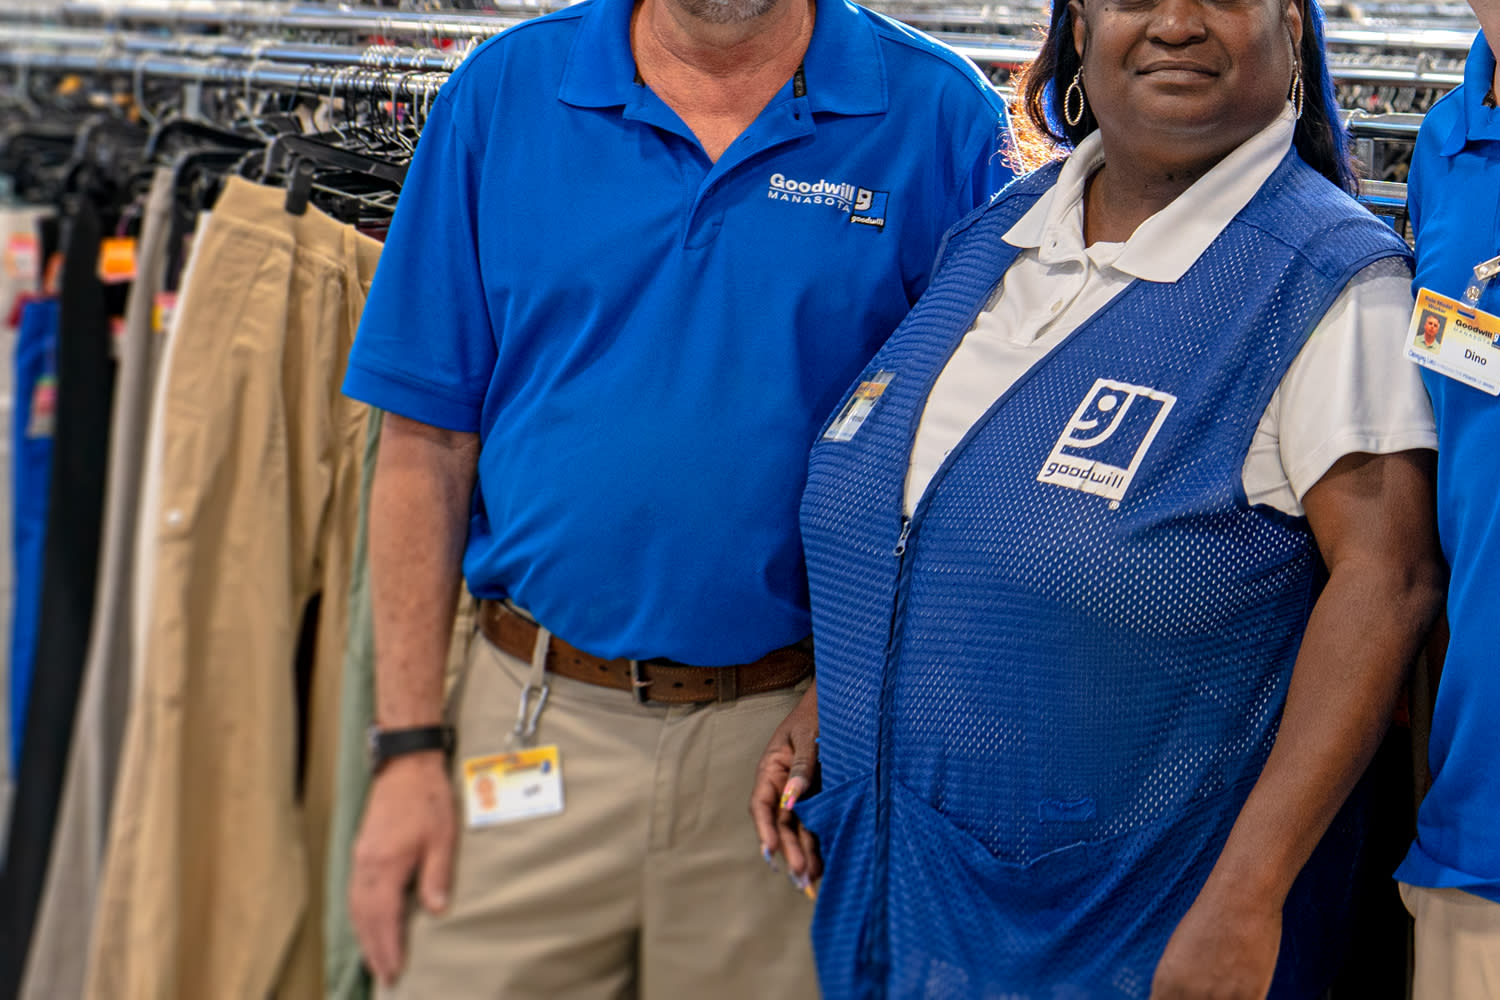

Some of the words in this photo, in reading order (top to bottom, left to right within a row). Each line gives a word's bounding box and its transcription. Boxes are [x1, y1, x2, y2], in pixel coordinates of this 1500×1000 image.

[769, 173, 855, 201] Goodwill
[767, 190, 850, 213] MANASOTA
[851, 215, 884, 226] goodwill
[1456, 319, 1493, 338] Goodwill
[1464, 348, 1487, 366] Dino
[1044, 462, 1124, 488] goodwill
